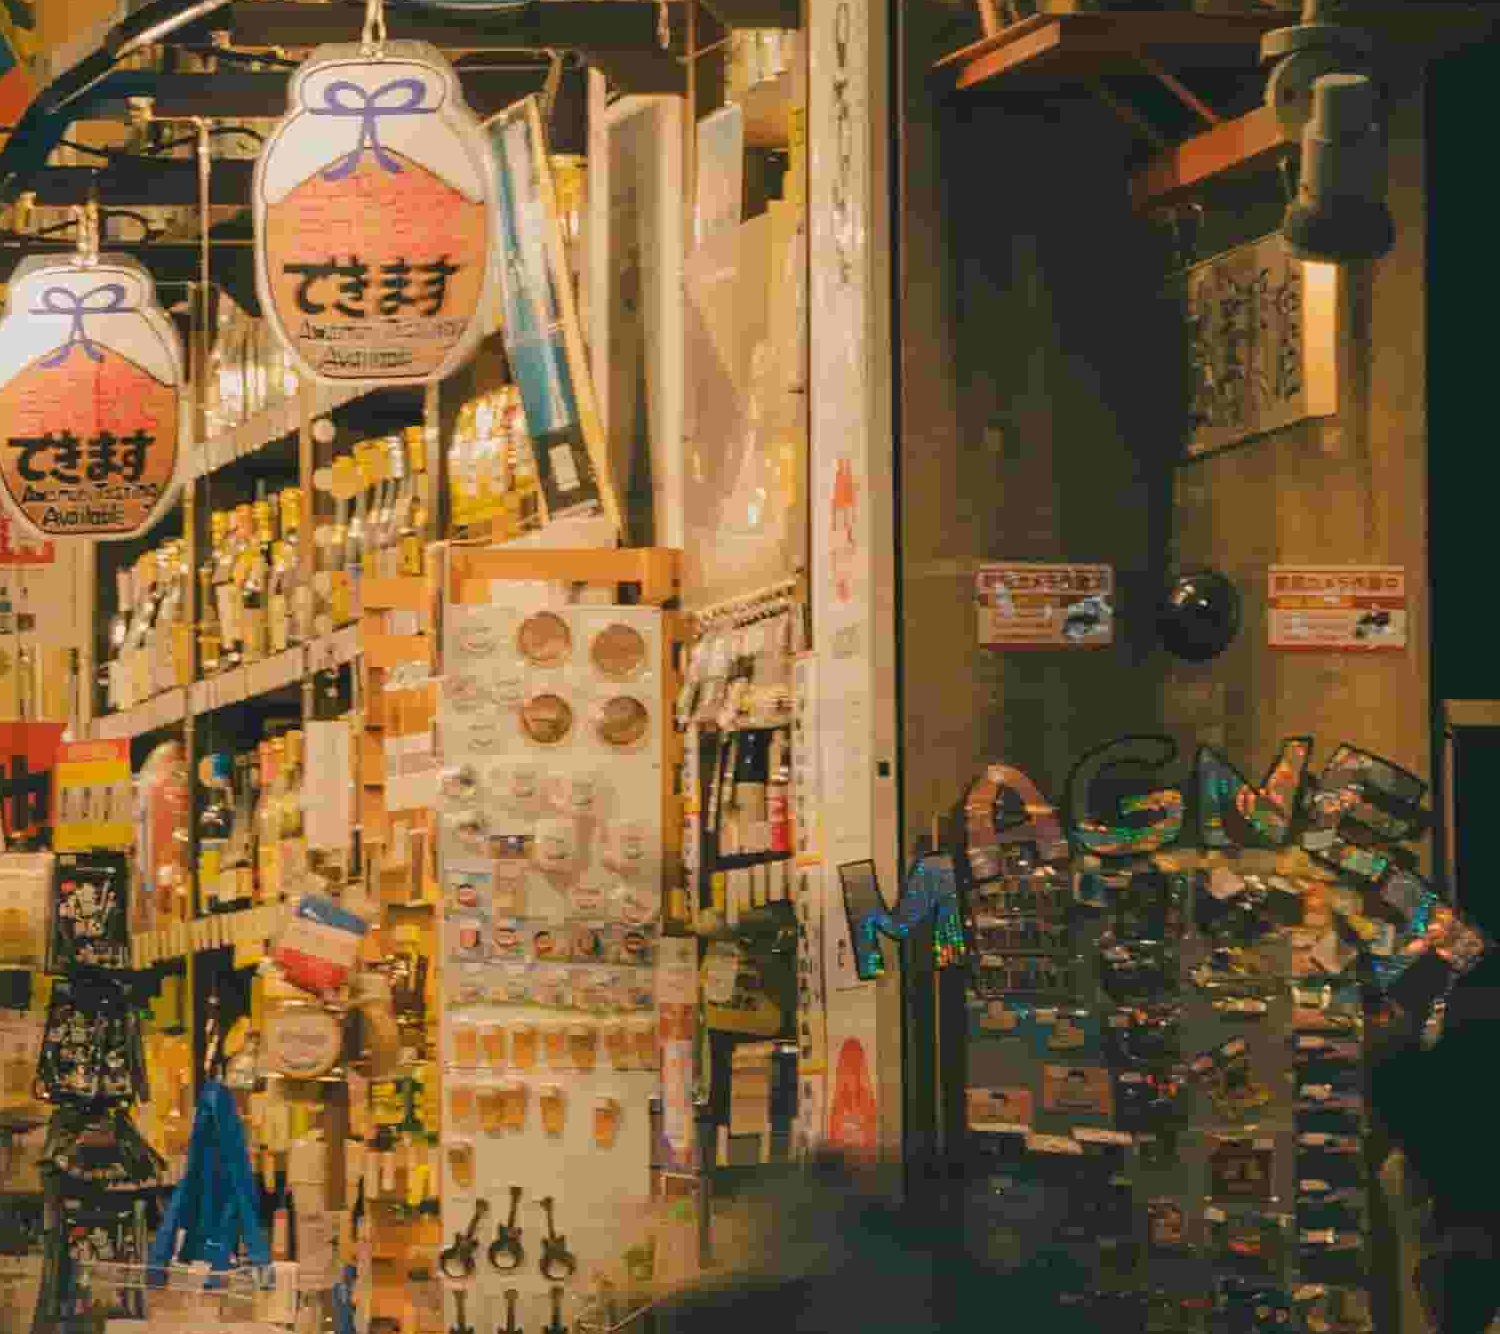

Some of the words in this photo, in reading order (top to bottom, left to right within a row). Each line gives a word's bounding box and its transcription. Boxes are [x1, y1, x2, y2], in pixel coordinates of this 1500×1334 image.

[283, 255, 462, 317] できます
[6, 430, 156, 485] できます
